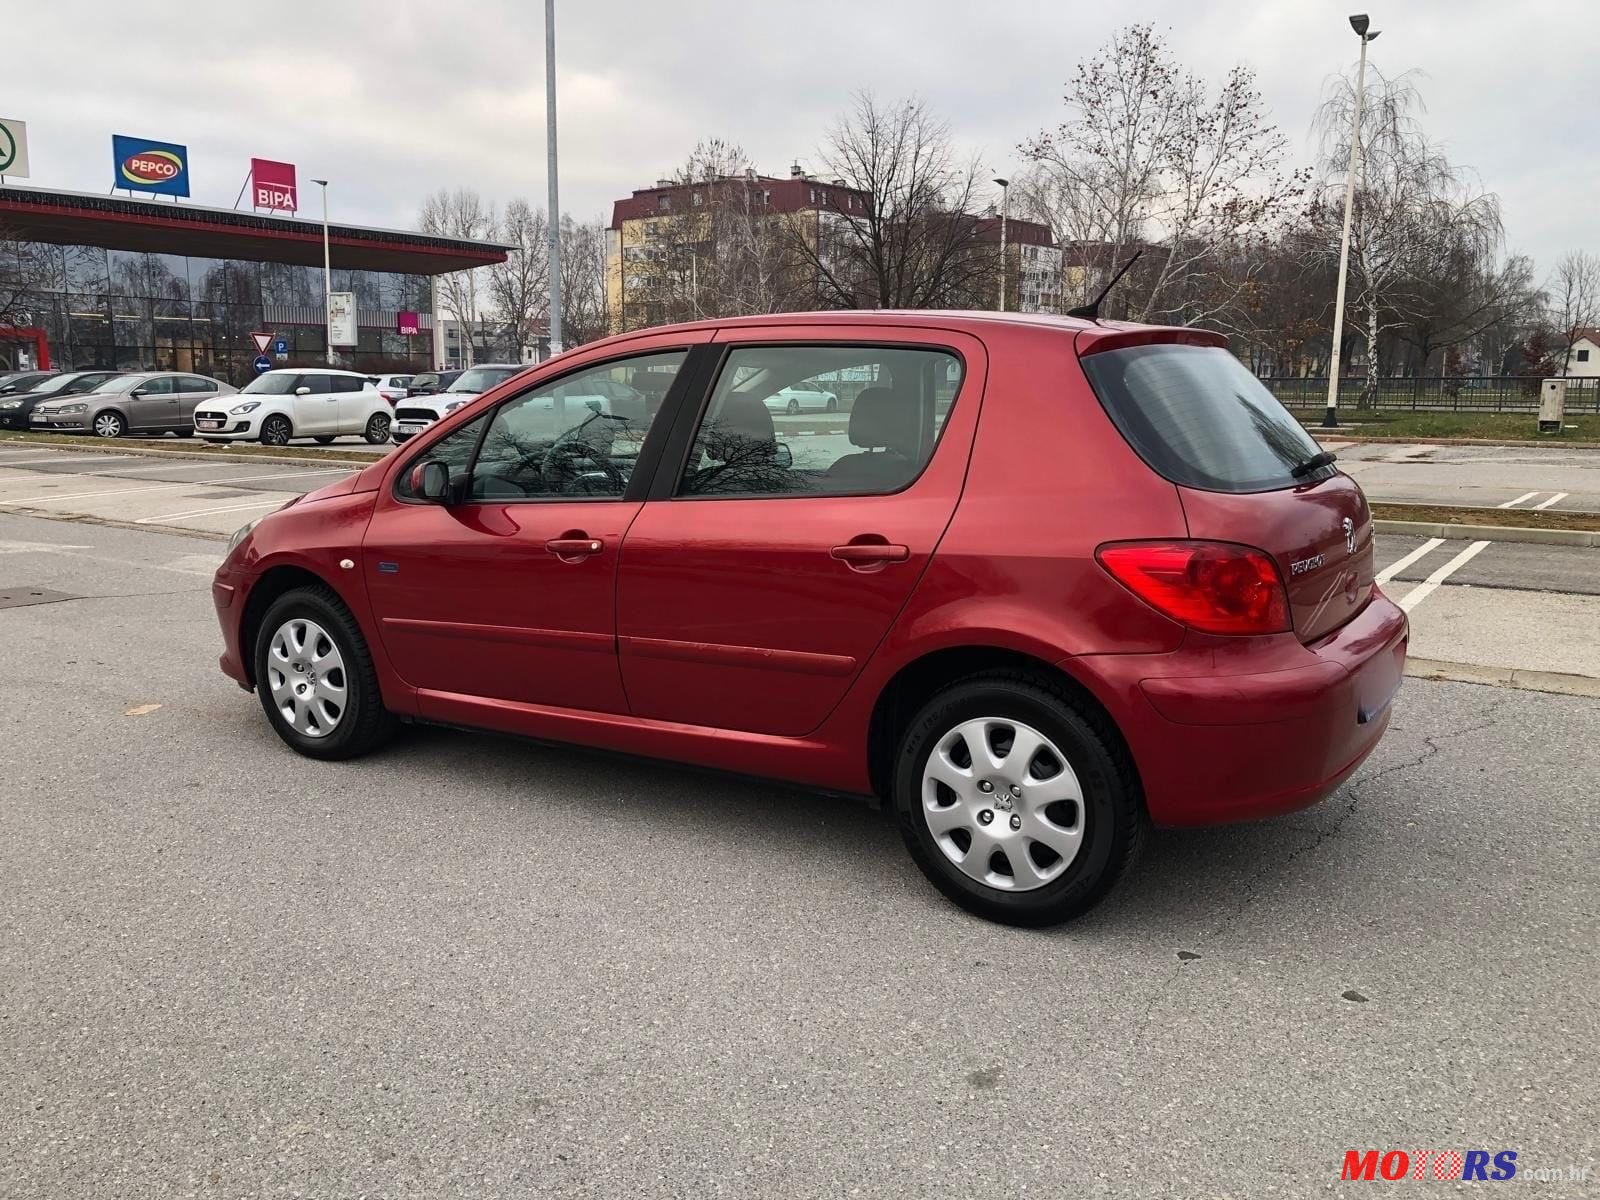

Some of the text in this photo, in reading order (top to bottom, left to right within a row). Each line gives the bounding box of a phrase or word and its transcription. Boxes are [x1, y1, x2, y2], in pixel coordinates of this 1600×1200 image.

[131, 159, 174, 176] PEPCO
[258, 189, 295, 208] BIPA
[401, 327, 418, 335] BIPA
[278, 343, 285, 352] P
